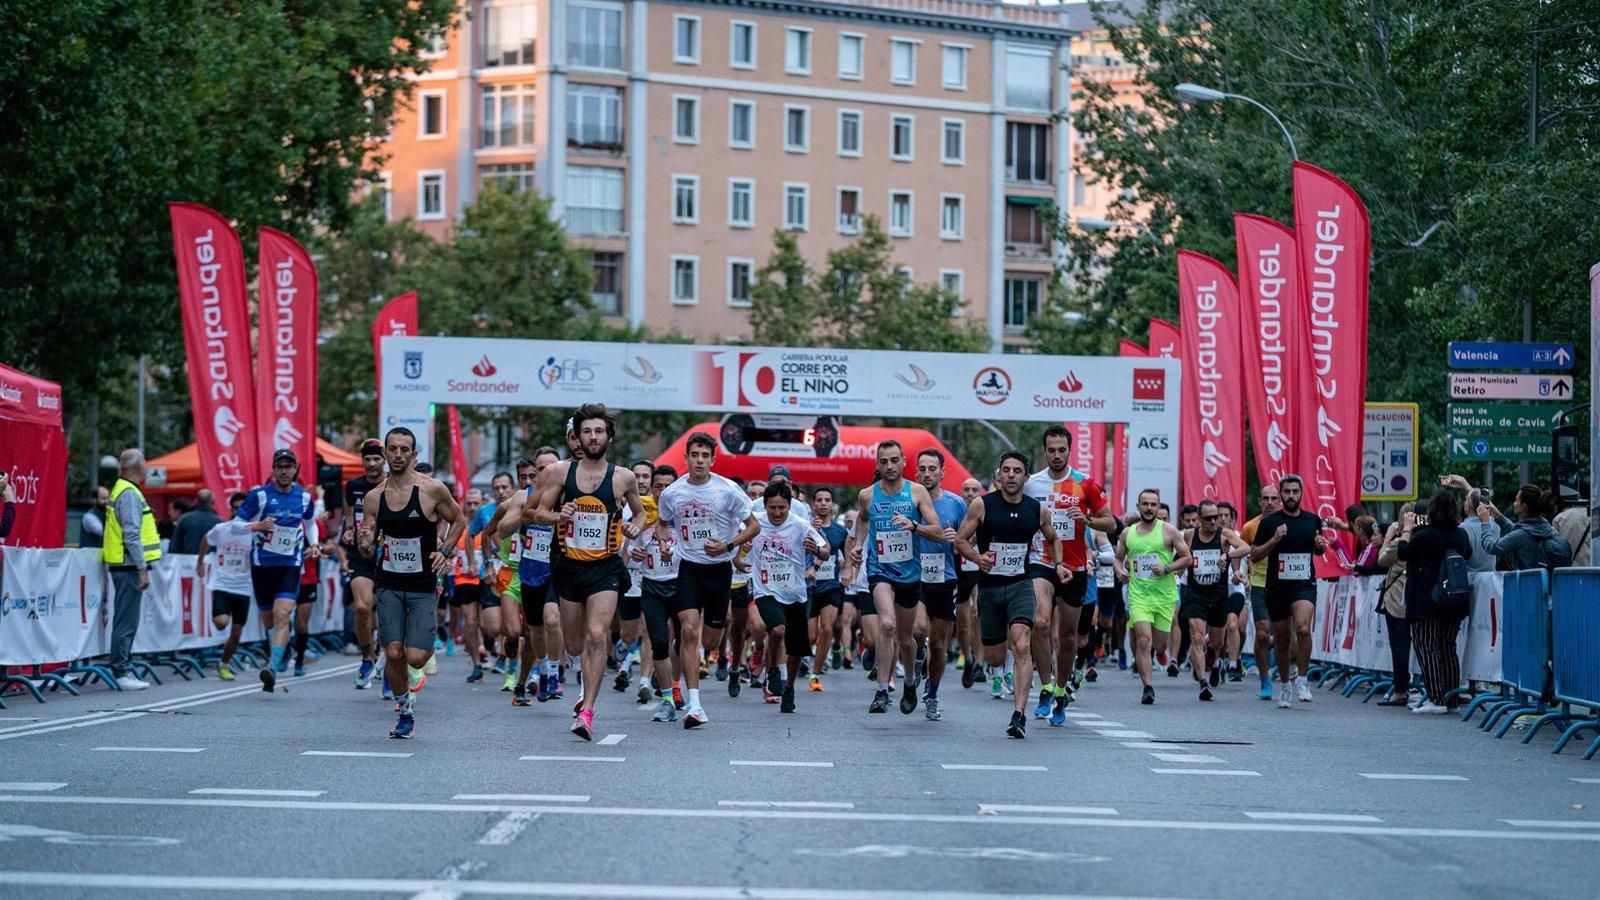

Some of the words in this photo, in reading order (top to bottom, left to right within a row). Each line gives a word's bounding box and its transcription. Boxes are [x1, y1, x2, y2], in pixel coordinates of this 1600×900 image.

[781, 353, 815, 362] CARRERA
[816, 354, 849, 363] POPULAR
[1454, 350, 1499, 360] Valencia
[781, 363, 820, 374] CORRE
[823, 364, 848, 376] POR
[711, 352, 778, 407] 10
[1453, 376, 1476, 384] Junta
[1479, 377, 1518, 385] Municipal
[394, 383, 431, 392] MADRID
[447, 379, 520, 394] Santander
[781, 377, 799, 393] EL
[975, 389, 1010, 397] MAPOMA
[1453, 386, 1486, 395] Retiro
[1033, 395, 1107, 409] Santander
[1452, 407, 1474, 415] plaza
[1477, 407, 1488, 415] de
[1364, 412, 1412, 421] RECAUCIÓN
[1452, 416, 1494, 427] Mariano
[1499, 416, 1512, 427] de
[1517, 417, 1546, 427] Cavia
[803, 429, 815, 446] 6
[1138, 436, 1169, 450] ACS
[1493, 445, 1524, 453] avenida
[1527, 443, 1552, 453] Naza
[1059, 493, 1081, 504] Cris
[577, 503, 603, 513] TRIDERS
[577, 528, 602, 539] 1552
[692, 529, 712, 539] 1591
[536, 543, 550, 553] 151
[888, 543, 908, 553] 1721
[392, 552, 416, 562] 1642
[1001, 556, 1022, 567] 1397
[1203, 559, 1216, 567] 309
[1288, 564, 1305, 572] 1363
[924, 565, 939, 574] 342
[772, 573, 791, 582] 1847
